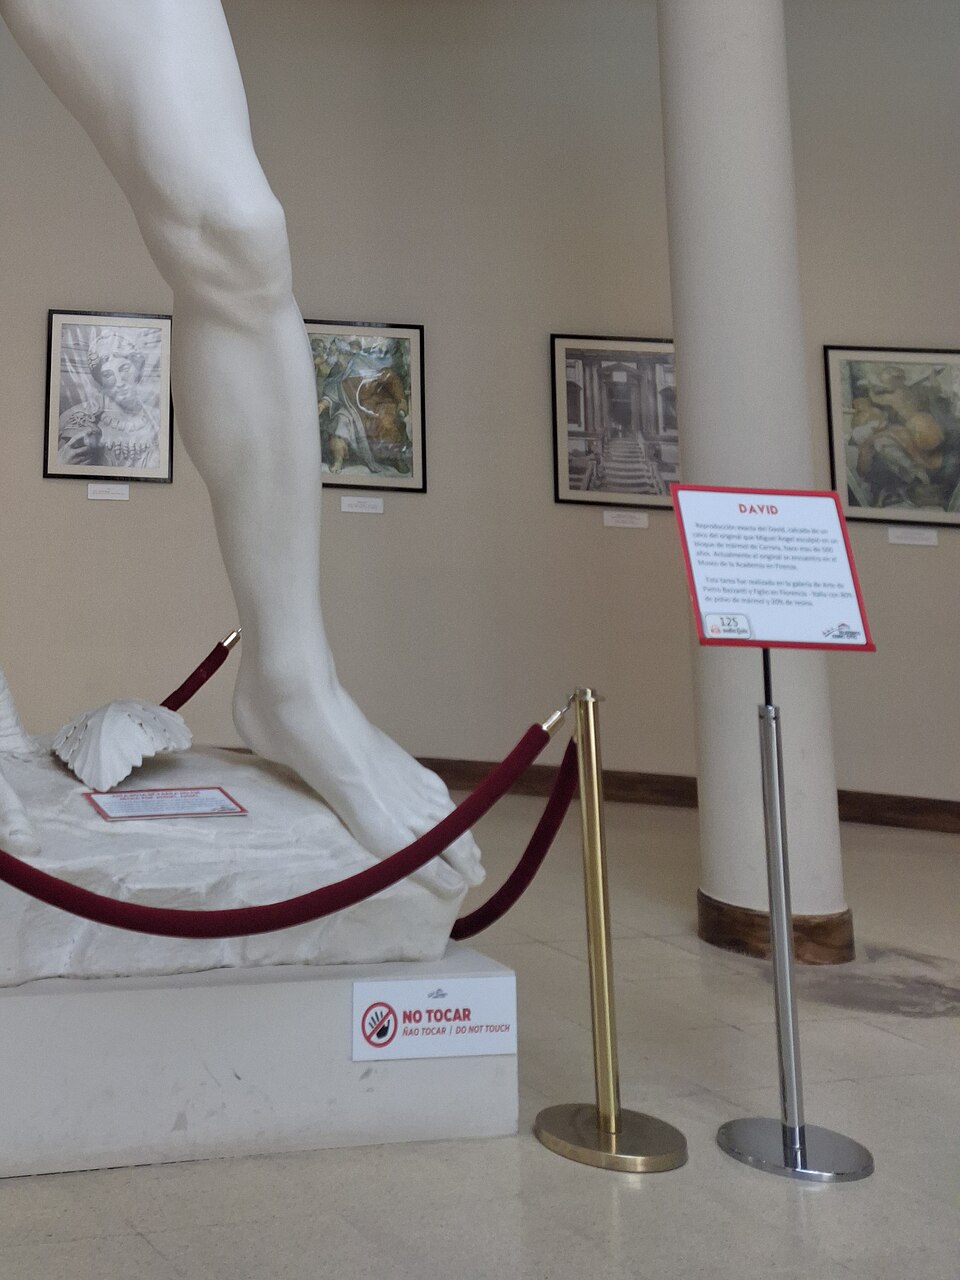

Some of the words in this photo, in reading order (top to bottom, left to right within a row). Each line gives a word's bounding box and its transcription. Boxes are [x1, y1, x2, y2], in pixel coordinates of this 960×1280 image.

[738, 504, 778, 515] DAVID
[720, 617, 738, 627] 125
[403, 1010, 422, 1023] NO
[426, 1008, 471, 1022] TOCAR
[421, 1027, 446, 1036] TOCAR
[455, 1026, 466, 1034] DO
[468, 1025, 484, 1033] NOT
[486, 1024, 510, 1033] TOUCH
